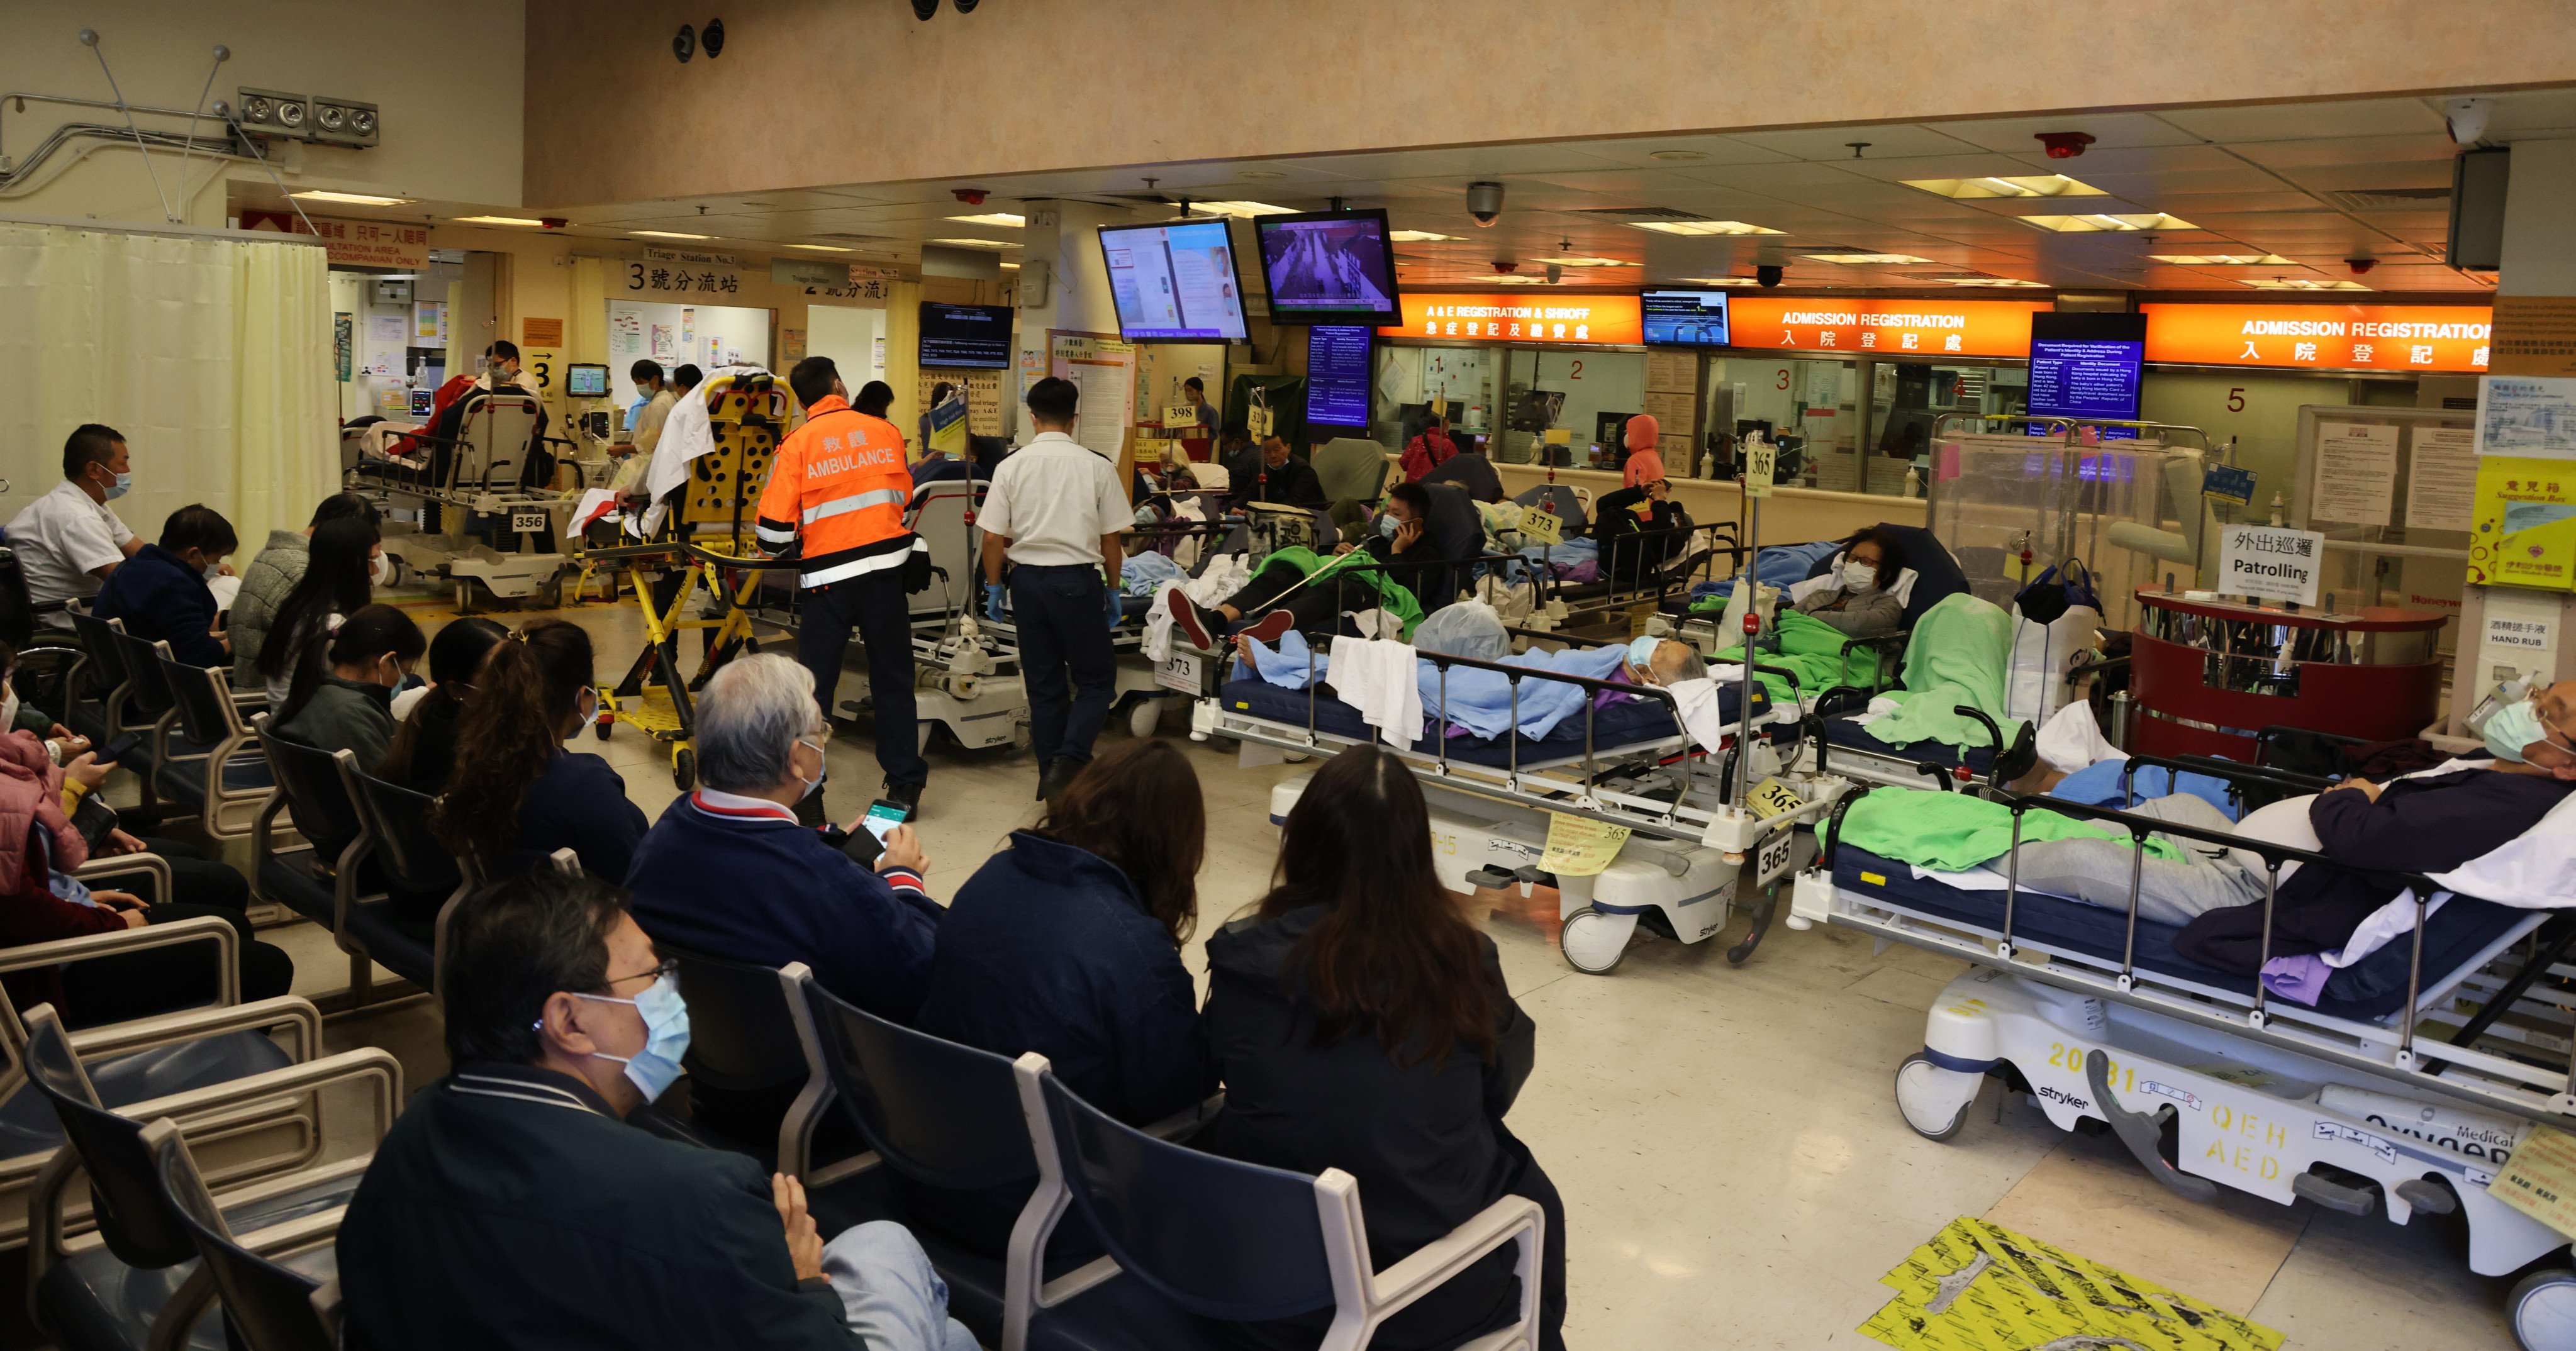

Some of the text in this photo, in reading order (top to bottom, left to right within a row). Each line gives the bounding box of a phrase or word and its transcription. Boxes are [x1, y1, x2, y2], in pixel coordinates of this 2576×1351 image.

[357, 225, 427, 246] 只可一人陪同
[326, 252, 421, 265] CCOMPANIAN ONLY
[375, 247, 400, 255] AREA
[647, 248, 735, 265] Triage Station No.3
[629, 263, 738, 293] 3號分流站
[793, 275, 810, 283] Triage
[1427, 306, 1591, 320] A & E REGISTRATION & SHROFF
[1782, 312, 1965, 328] ADMISSION REGISTRATION
[1425, 321, 1589, 340] 急症登記及繳費處
[2242, 320, 2345, 336] ADMISSION
[1781, 330, 1962, 352] 入院登記處
[2240, 340, 2490, 367] 入院登記處
[1435, 356, 1441, 374] 1
[1570, 360, 1583, 380] 2
[534, 362, 550, 388] 3
[1776, 369, 1790, 391] 3
[1951, 376, 1966, 398] 4
[2228, 387, 2245, 413] 5
[1171, 406, 1193, 419] 398
[822, 429, 869, 453] 救護
[808, 448, 895, 480] AMBULANCE
[1753, 451, 1770, 475] 365
[2496, 491, 2546, 502] Suggestion
[2507, 481, 2560, 493] 意見箱
[515, 516, 543, 528] 356
[1527, 513, 1553, 531] 373
[2234, 531, 2314, 557] 外出巡邏
[2234, 559, 2309, 584] Patrolling
[2490, 620, 2546, 634] 酒精搓手液
[2492, 635, 2519, 644] HAND
[1167, 657, 1190, 676] 373
[985, 735, 1006, 744] stryker
[1604, 826, 1627, 840] 365
[1761, 840, 1790, 875] 365
[1699, 923, 1719, 937] stryker
[2039, 1086, 2089, 1109] stryker
[2212, 1105, 2285, 1149] QEH
[2457, 1125, 2514, 1148] Medical
[2206, 1138, 2279, 1181] AED
